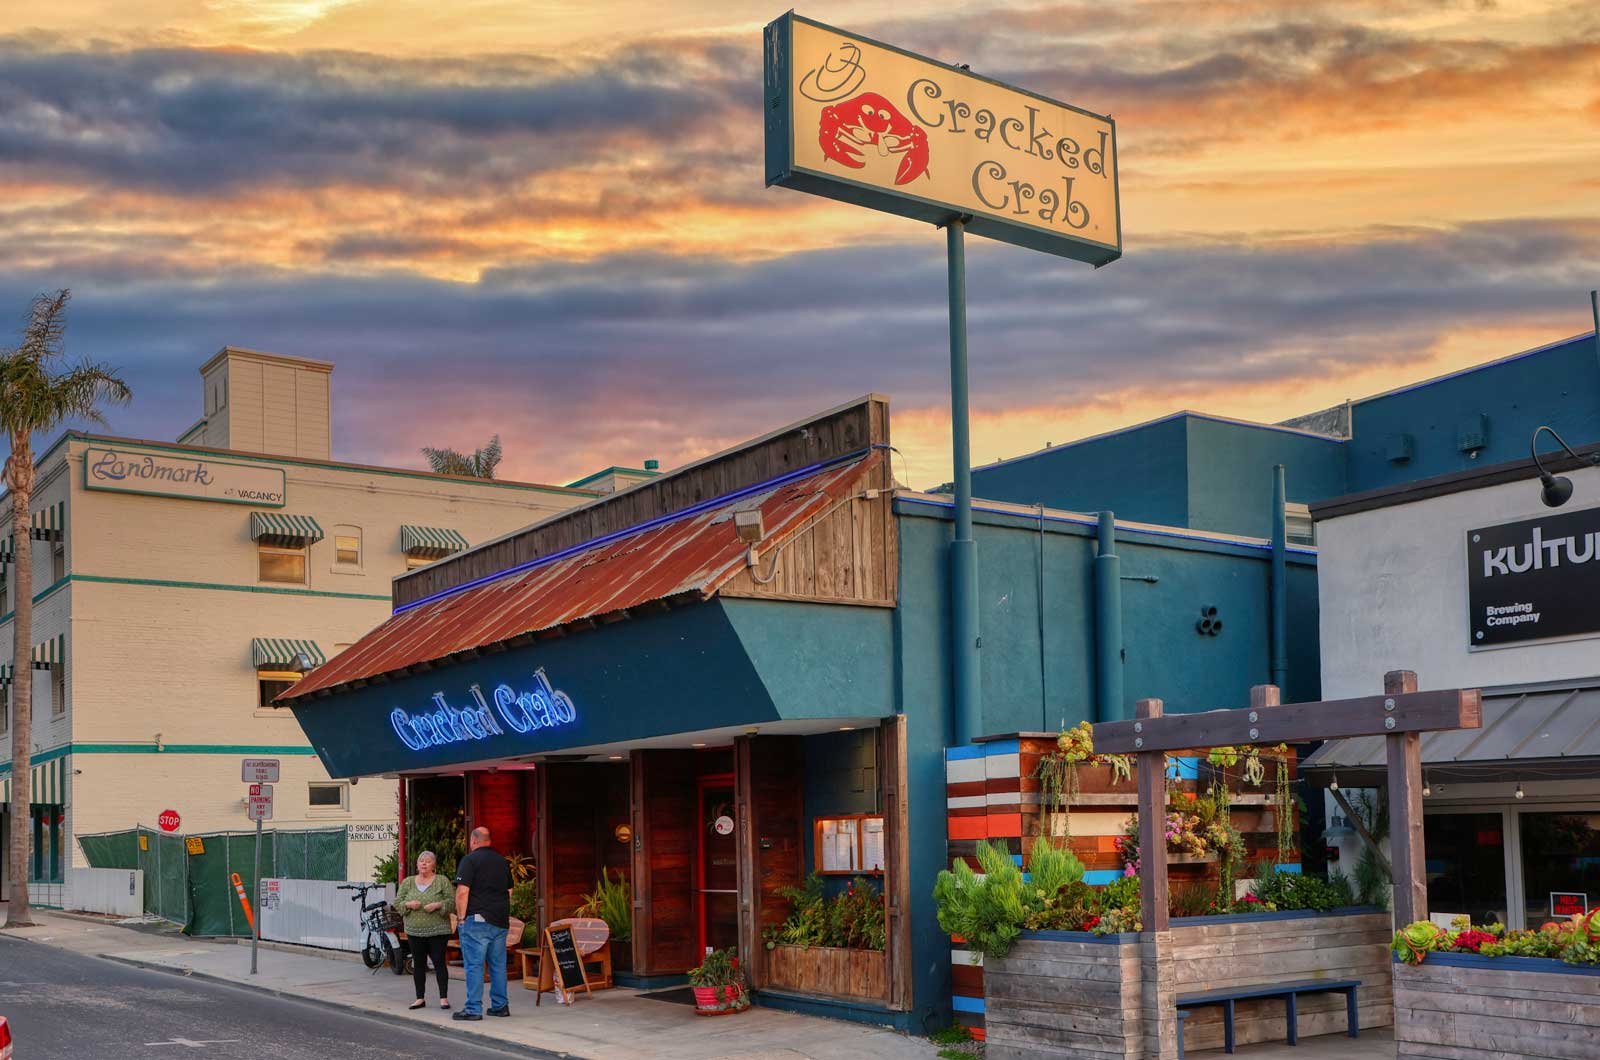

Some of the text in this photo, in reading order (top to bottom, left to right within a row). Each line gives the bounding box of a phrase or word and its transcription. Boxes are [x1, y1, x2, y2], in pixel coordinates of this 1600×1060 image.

[906, 78, 1109, 179] Cracked
[972, 160, 1090, 229] Crab
[91, 450, 214, 486] Landmark
[238, 489, 282, 502] VACANCY
[1486, 602, 1533, 615] Brewing
[1487, 612, 1540, 626] Company
[391, 666, 576, 750] Cracked Crab
[251, 786, 260, 794] NO
[160, 815, 179, 826] STOP
[355, 824, 385, 832] SMOKING
